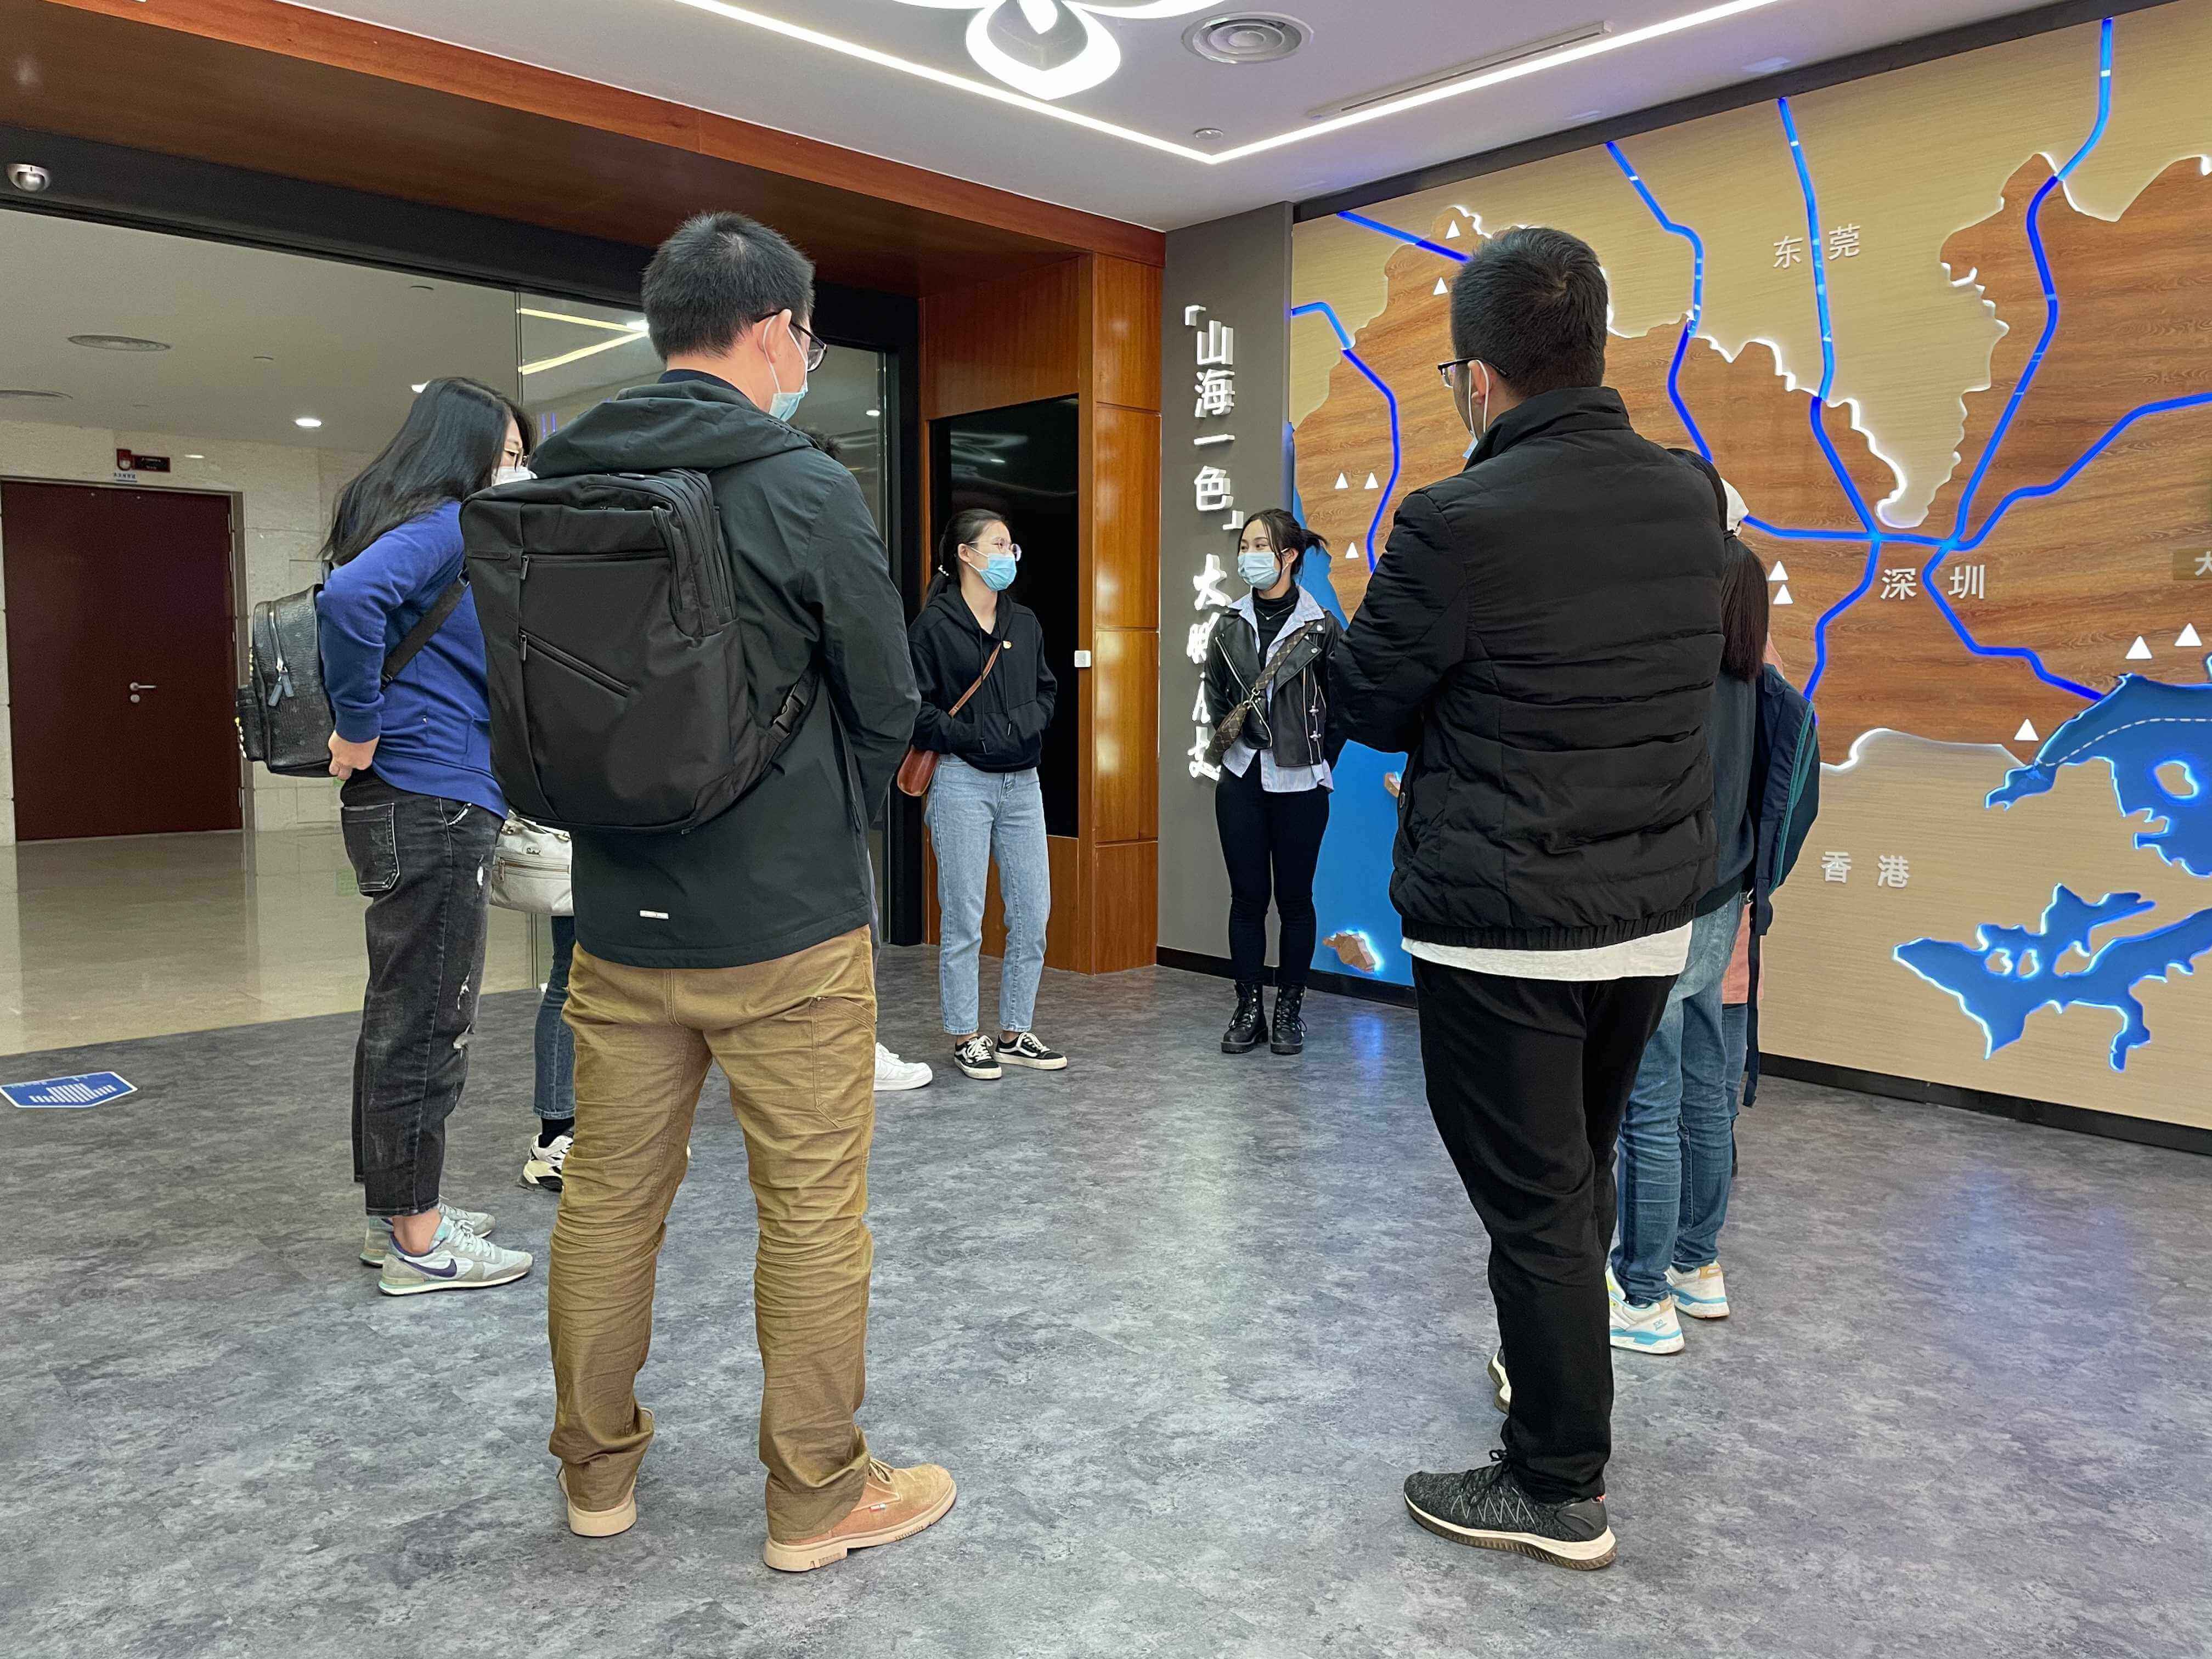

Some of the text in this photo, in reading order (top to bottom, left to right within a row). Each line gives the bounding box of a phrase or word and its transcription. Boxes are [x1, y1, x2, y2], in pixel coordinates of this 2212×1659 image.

[1773, 223, 1861, 269] 东莞
[1880, 565, 1985, 600] 深圳
[1821, 851, 1910, 888] 香港
